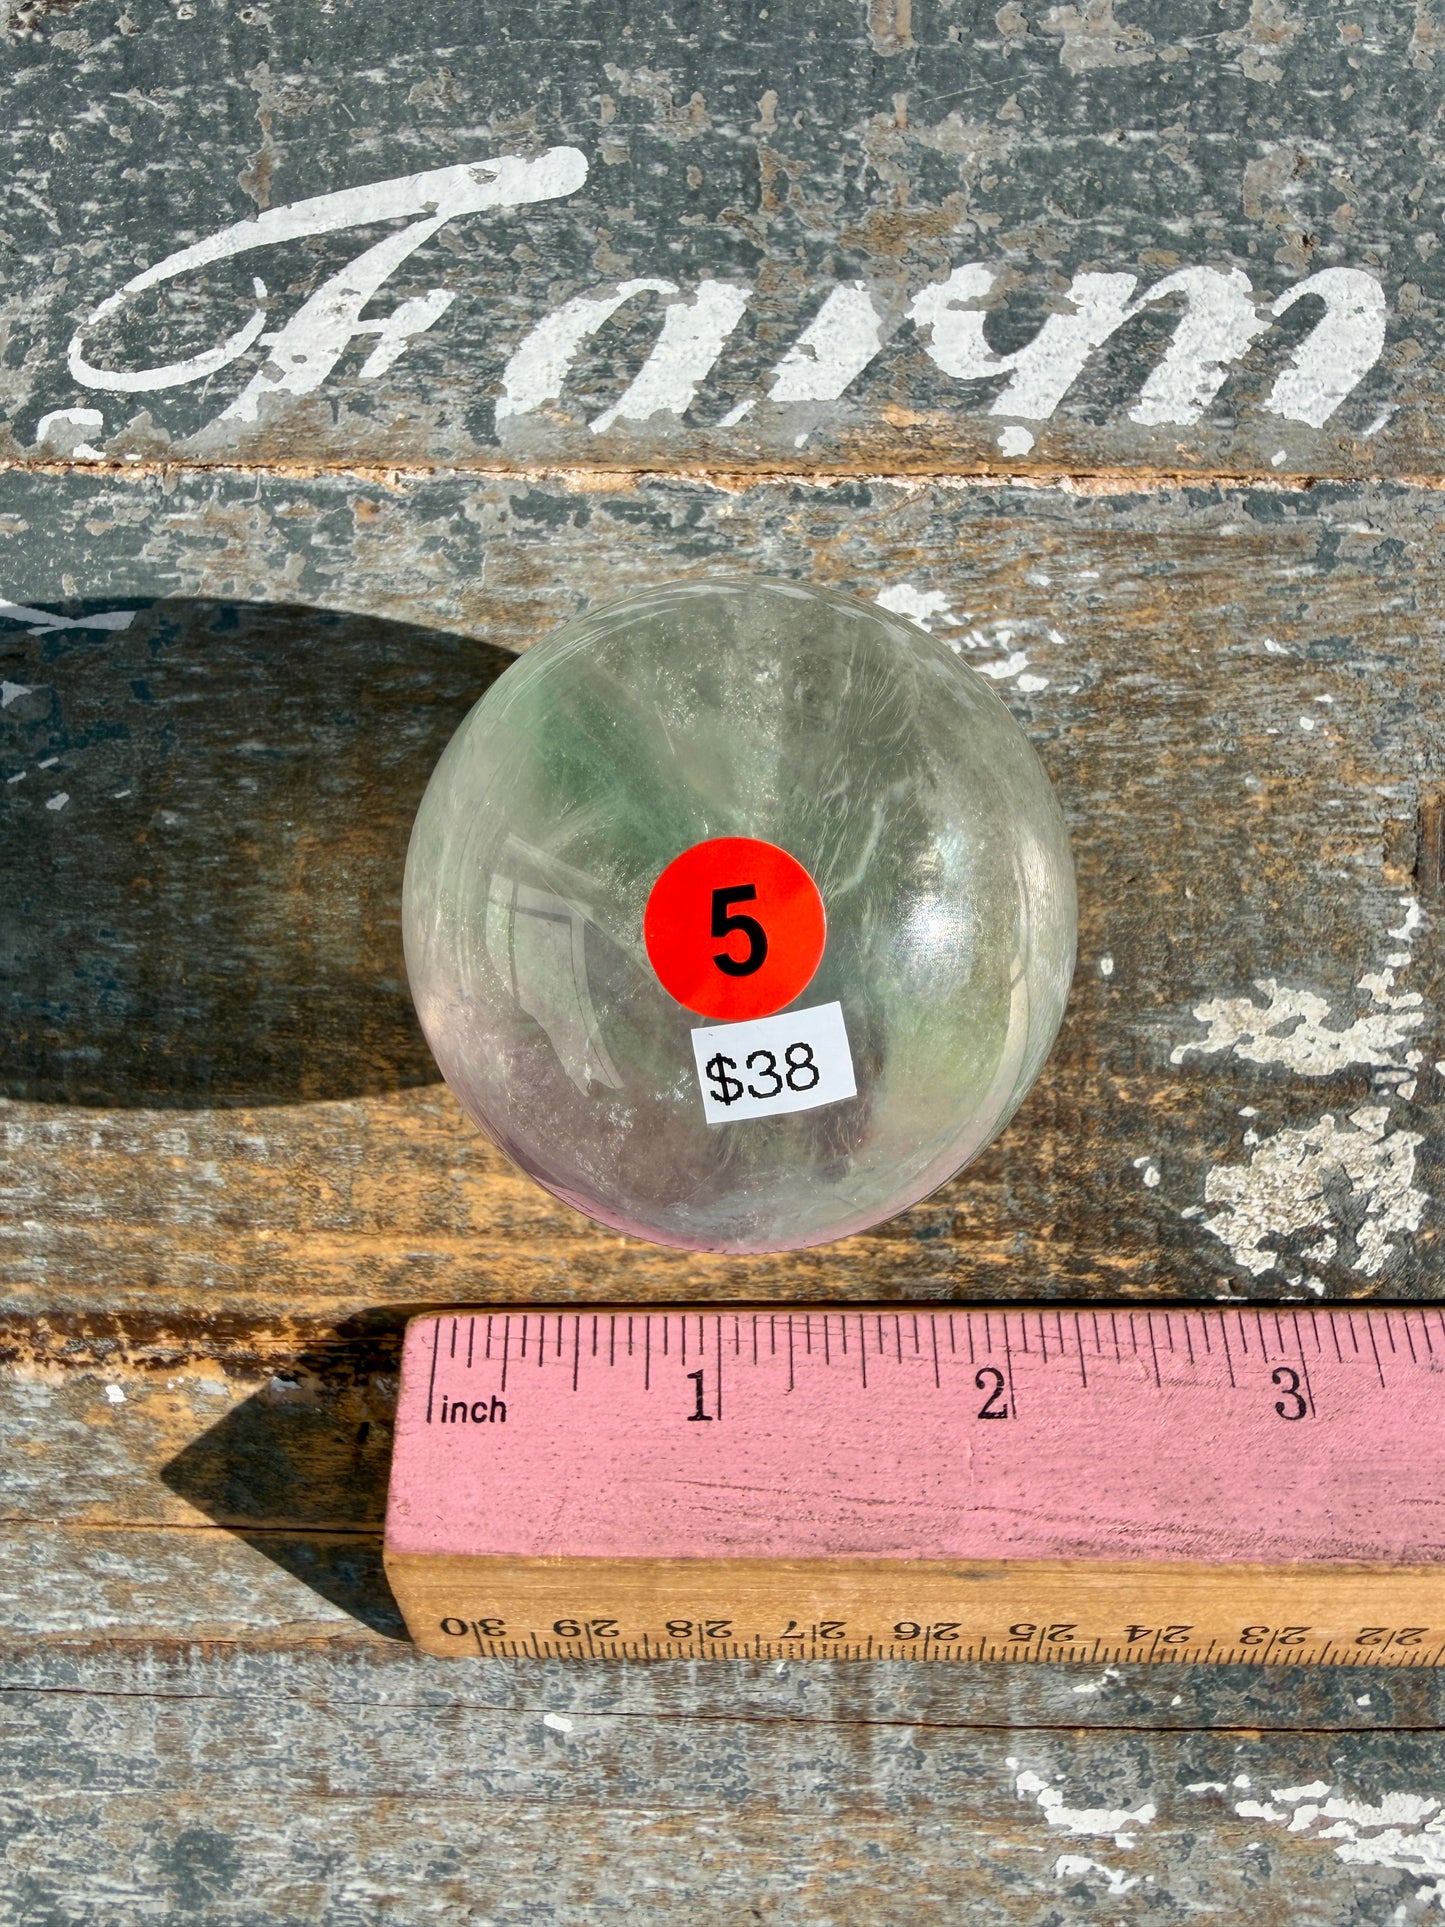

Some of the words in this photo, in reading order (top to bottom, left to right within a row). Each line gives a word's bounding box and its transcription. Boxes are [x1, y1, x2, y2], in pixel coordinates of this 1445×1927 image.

[710, 883, 769, 978] 5
[705, 1041, 821, 1107] $38
[441, 1395, 507, 1425] inch
[687, 1369, 714, 1422] 1
[975, 1367, 1008, 1420] 2
[1271, 1366, 1307, 1421] 3
[440, 1617, 508, 1638] 30
[552, 1618, 622, 1639] 29
[664, 1619, 734, 1640] 28
[780, 1621, 847, 1641] 27
[893, 1621, 963, 1642] 26
[1007, 1623, 1079, 1643] 25
[1123, 1624, 1196, 1645] 24
[1239, 1625, 1313, 1646] 23
[1355, 1626, 1430, 1647] 22
